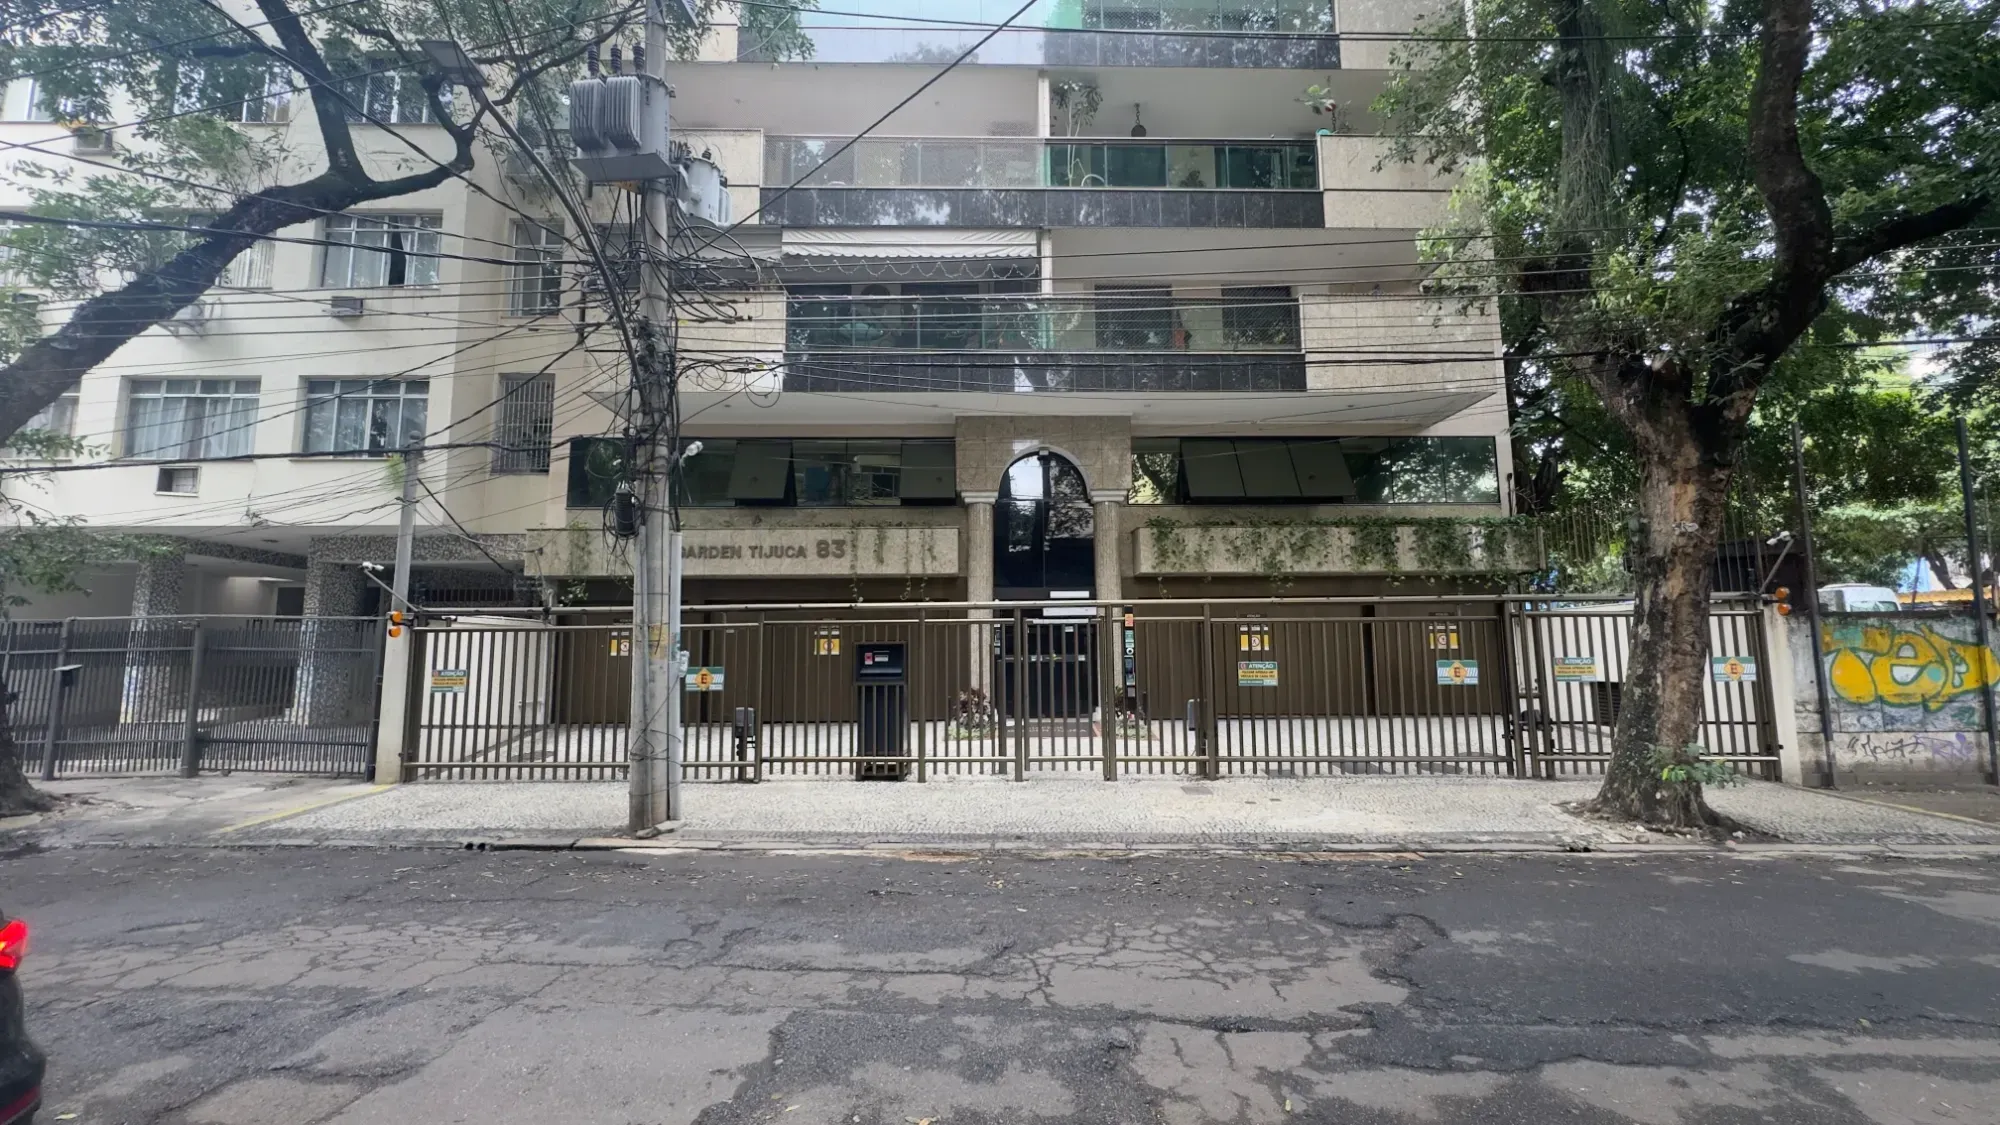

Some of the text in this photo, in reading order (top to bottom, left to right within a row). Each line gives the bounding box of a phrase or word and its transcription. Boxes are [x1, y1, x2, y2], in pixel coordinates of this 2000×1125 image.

[748, 545, 807, 560] TIJUCA
[815, 539, 846, 560] 83
[1248, 662, 1274, 670] ATENÇÃO
[1730, 663, 1738, 675] E
[1454, 667, 1461, 678] E
[701, 673, 708, 685] E
